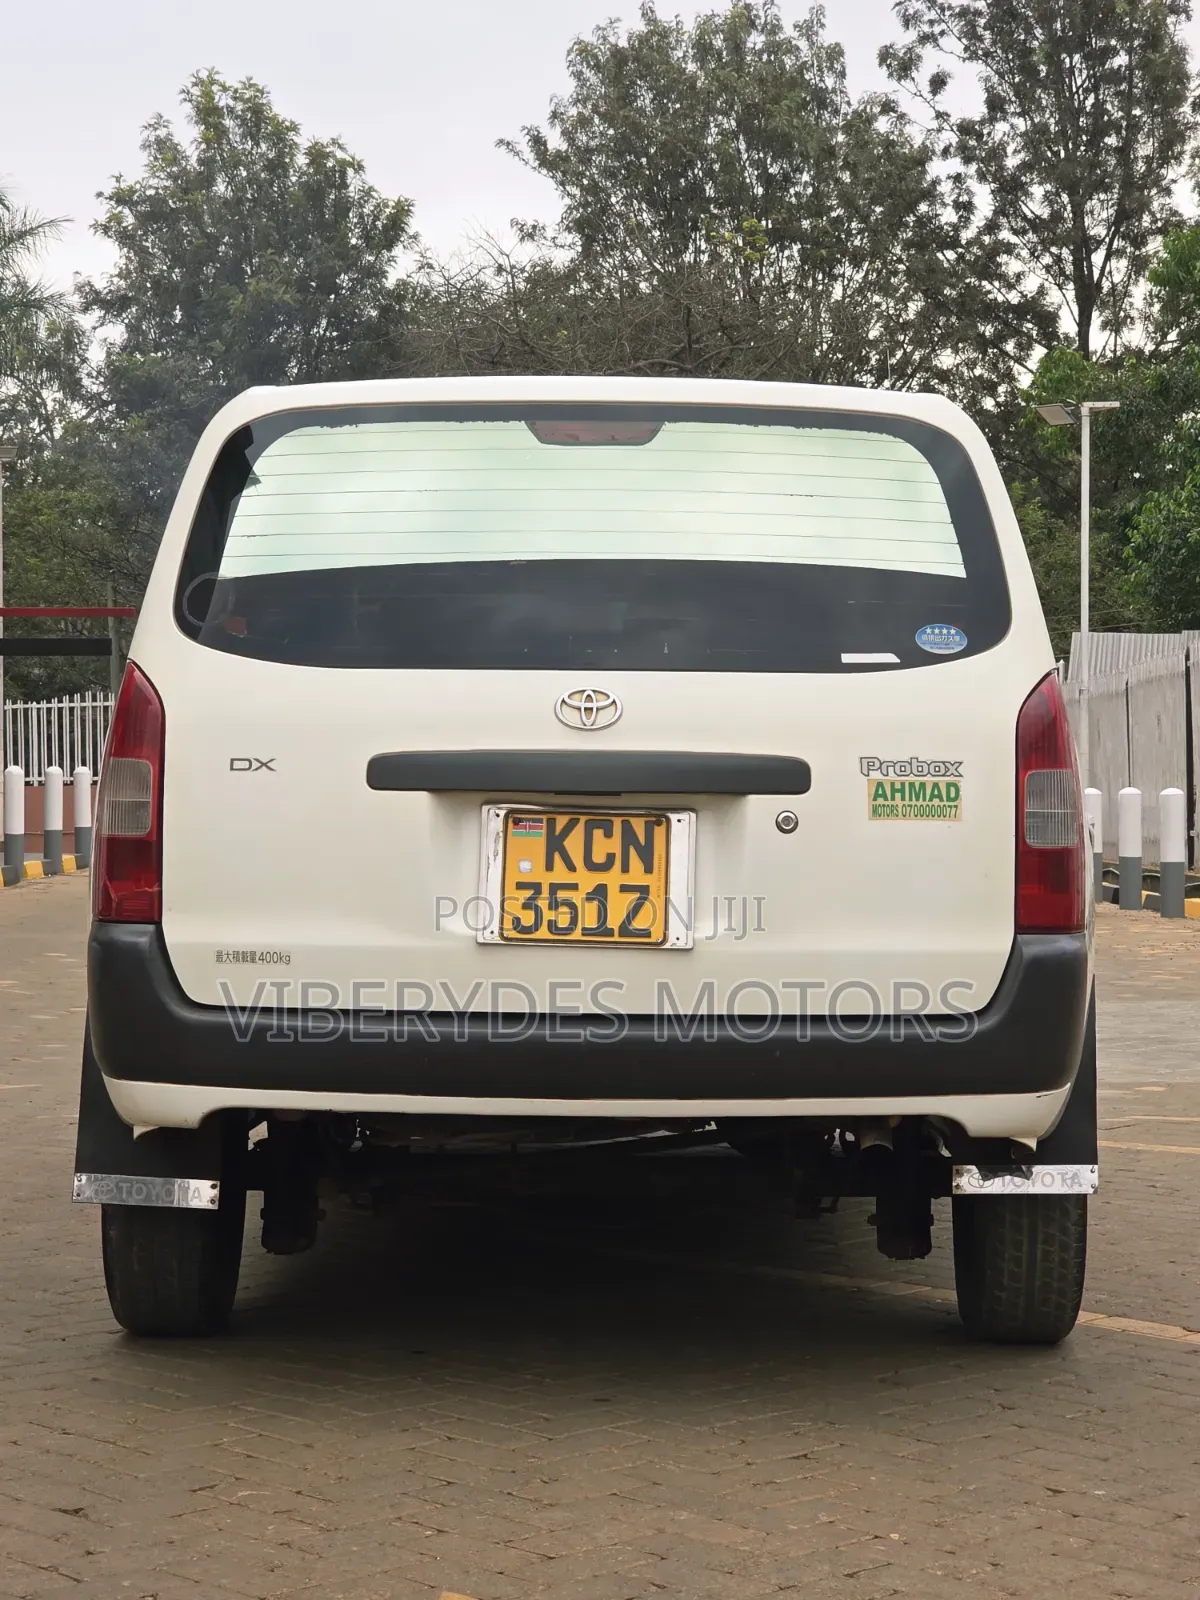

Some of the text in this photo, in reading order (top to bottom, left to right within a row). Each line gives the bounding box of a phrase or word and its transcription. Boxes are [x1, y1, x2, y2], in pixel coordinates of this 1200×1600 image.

[229, 757, 277, 771] DX
[859, 756, 964, 777] Probox
[872, 781, 961, 802] AHMAD
[871, 804, 958, 819] MOTORS 0700000077
[545, 817, 656, 874] KCN
[511, 881, 652, 938] 351Z
